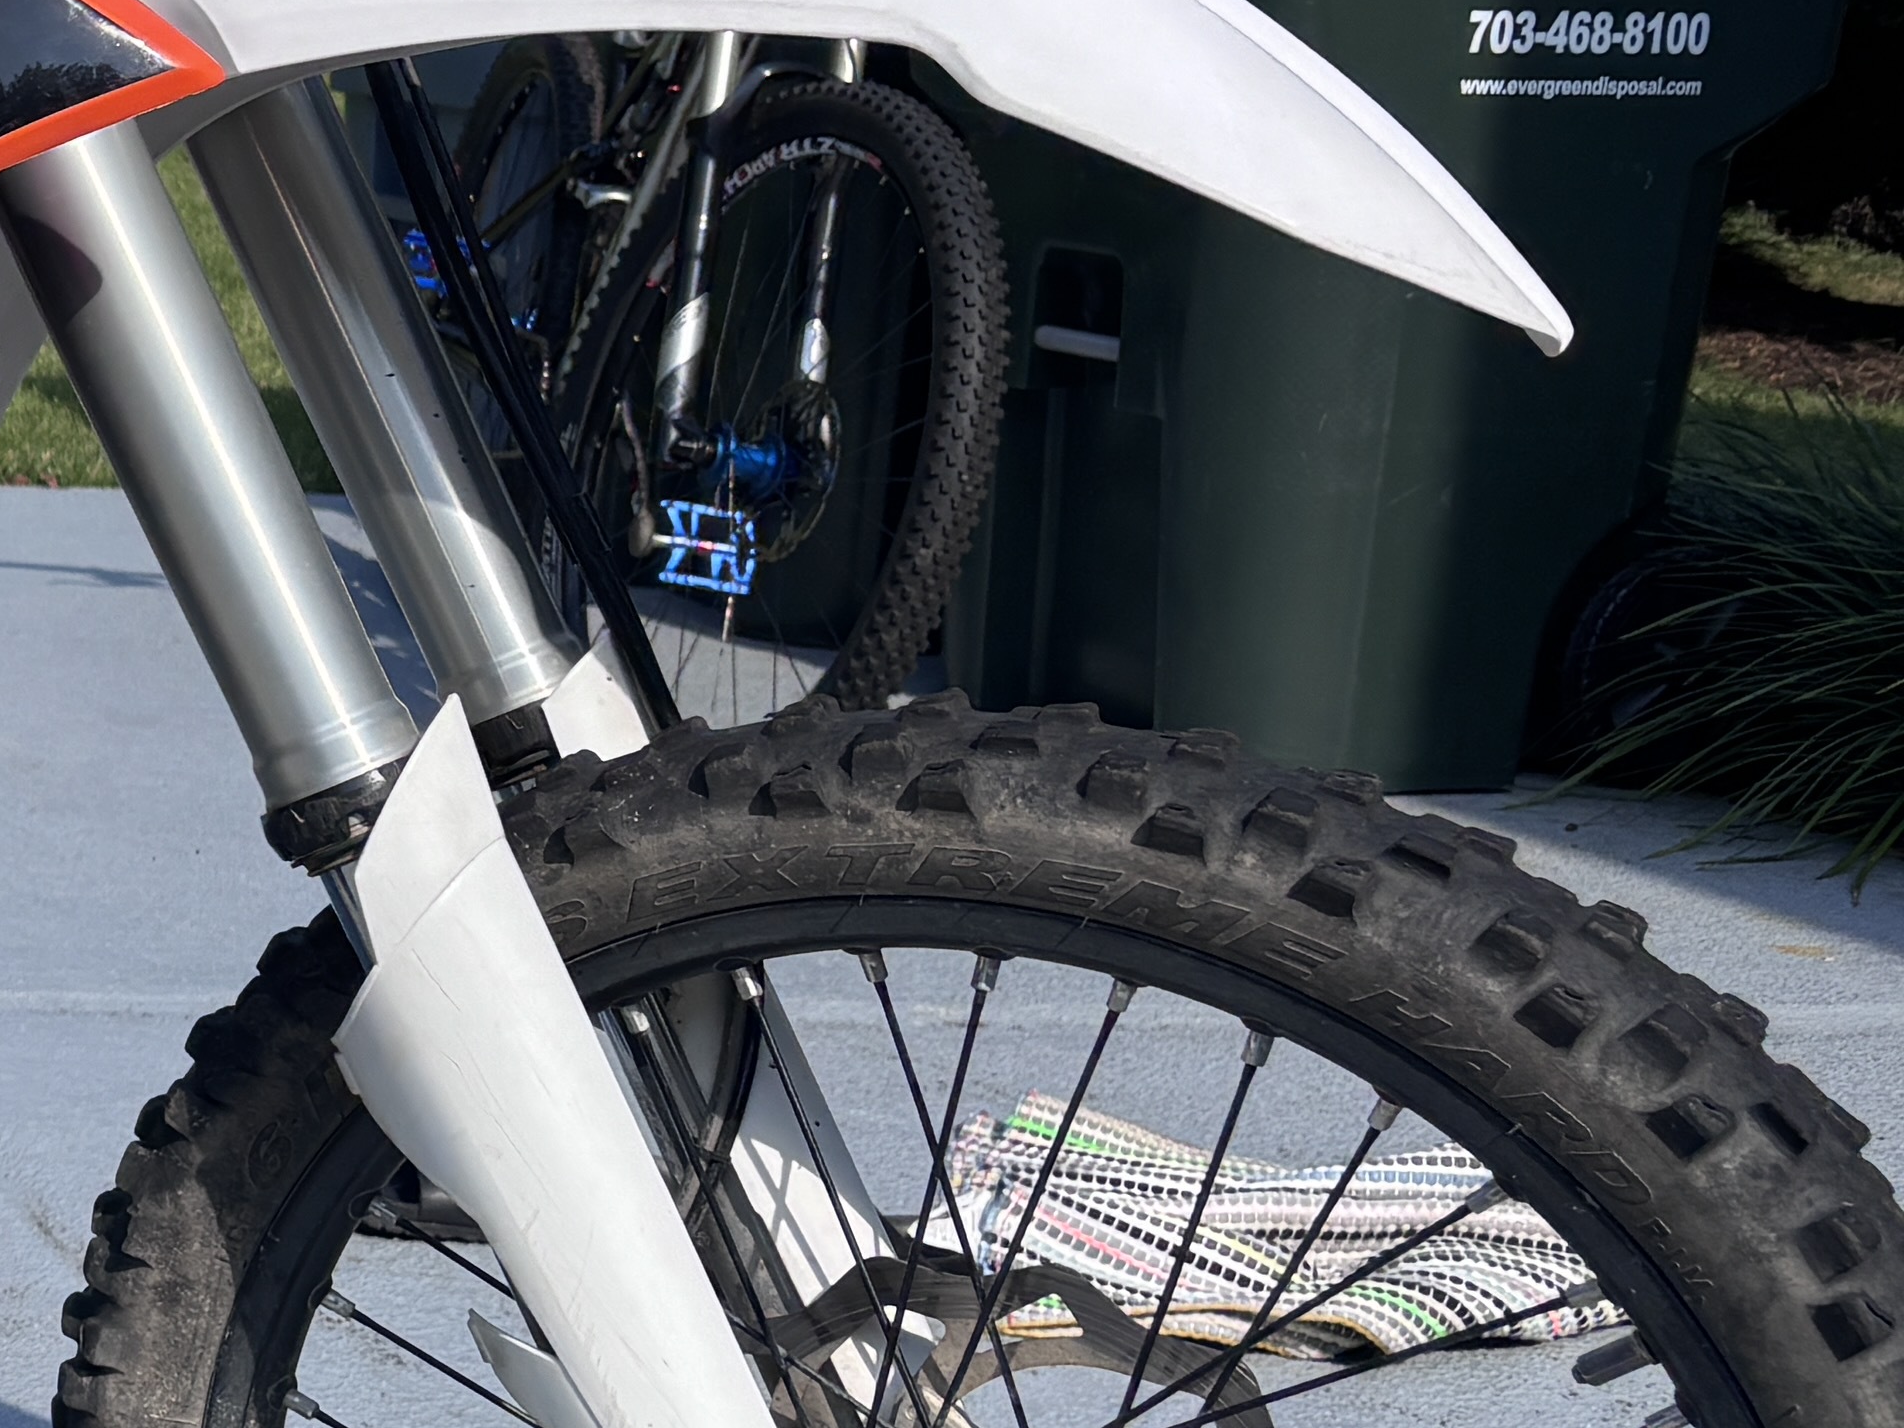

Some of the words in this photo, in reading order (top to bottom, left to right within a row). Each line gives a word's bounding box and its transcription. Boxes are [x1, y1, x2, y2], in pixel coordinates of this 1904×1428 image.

[1468, 10, 1711, 55] 703-468-8100
[1460, 75, 1702, 100] www.evergreendisposal.com
[626, 841, 1351, 980] EXTREME
[1346, 987, 1653, 1205] HARD
